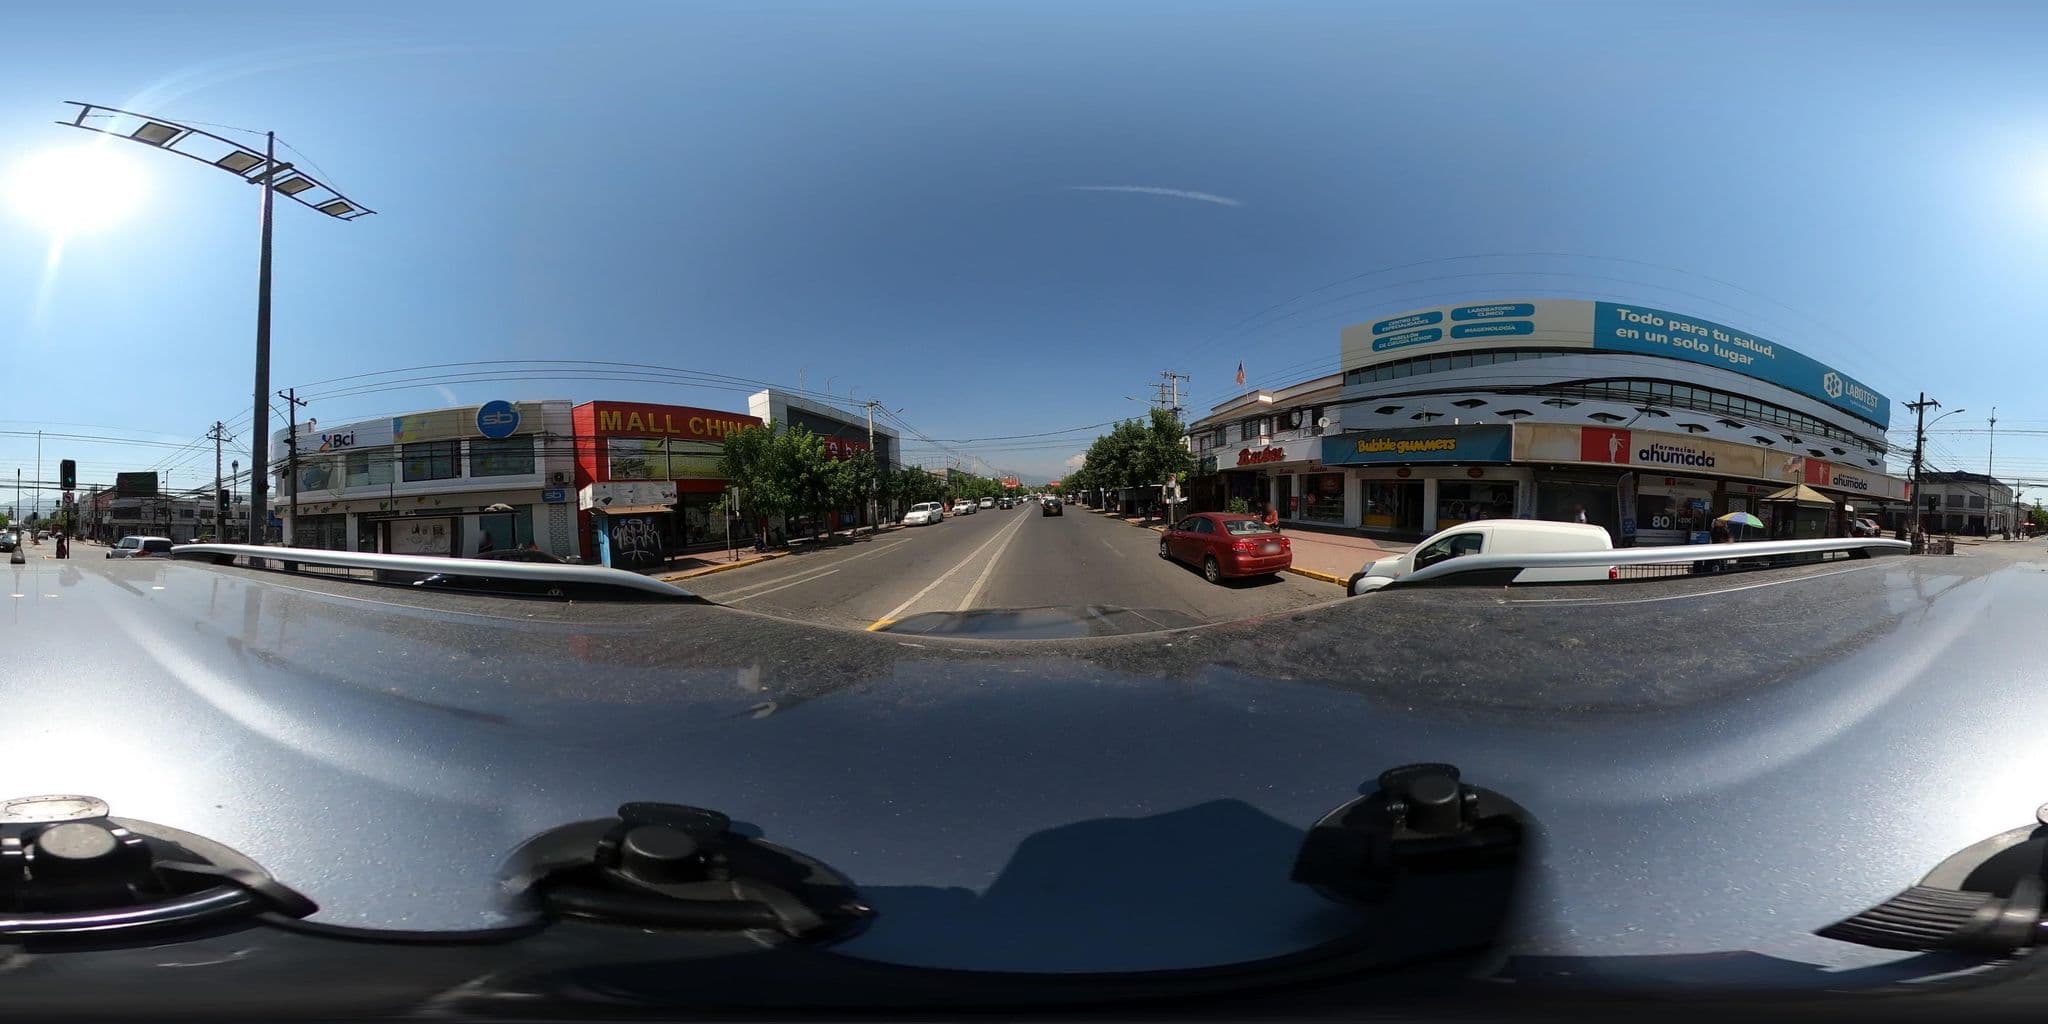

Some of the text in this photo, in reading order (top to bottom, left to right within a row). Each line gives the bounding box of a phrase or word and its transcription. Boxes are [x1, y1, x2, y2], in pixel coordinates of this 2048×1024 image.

[1616, 308, 1775, 359] Todo para tu salud,
[1616, 327, 1754, 365] en un solo lugar
[1845, 381, 1878, 408] LABOTEST
[481, 411, 513, 425] sb
[600, 410, 681, 434] MALL
[332, 430, 354, 448] Bci
[1655, 443, 1696, 453] farmacias
[1638, 444, 1716, 468] ahumada
[1833, 474, 1867, 490] ahumada
[1652, 515, 1670, 529] 80
